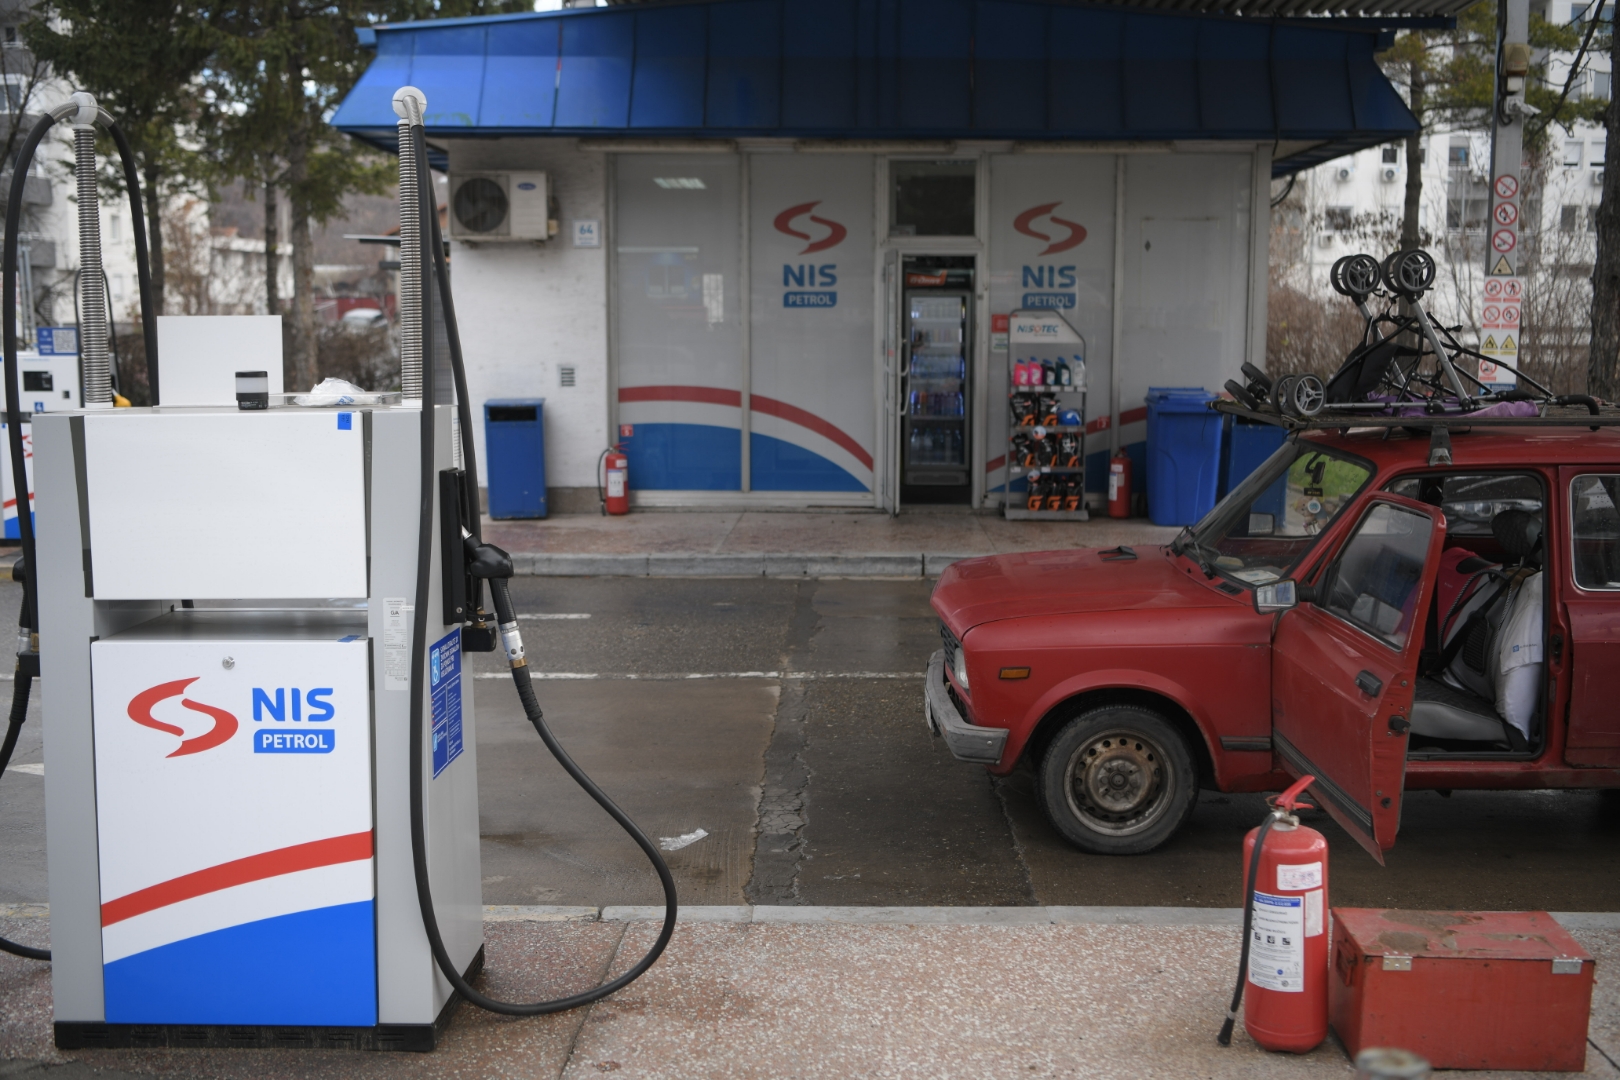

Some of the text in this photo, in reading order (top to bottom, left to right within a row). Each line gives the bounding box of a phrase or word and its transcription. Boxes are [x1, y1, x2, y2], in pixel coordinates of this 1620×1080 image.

[579, 224, 594, 235] 64
[783, 264, 838, 288] NIS
[1022, 265, 1077, 288] NIS
[788, 295, 833, 305] PETROL
[1027, 296, 1071, 307] PETROL
[252, 687, 335, 722] NIS
[262, 733, 329, 749] PETROL
